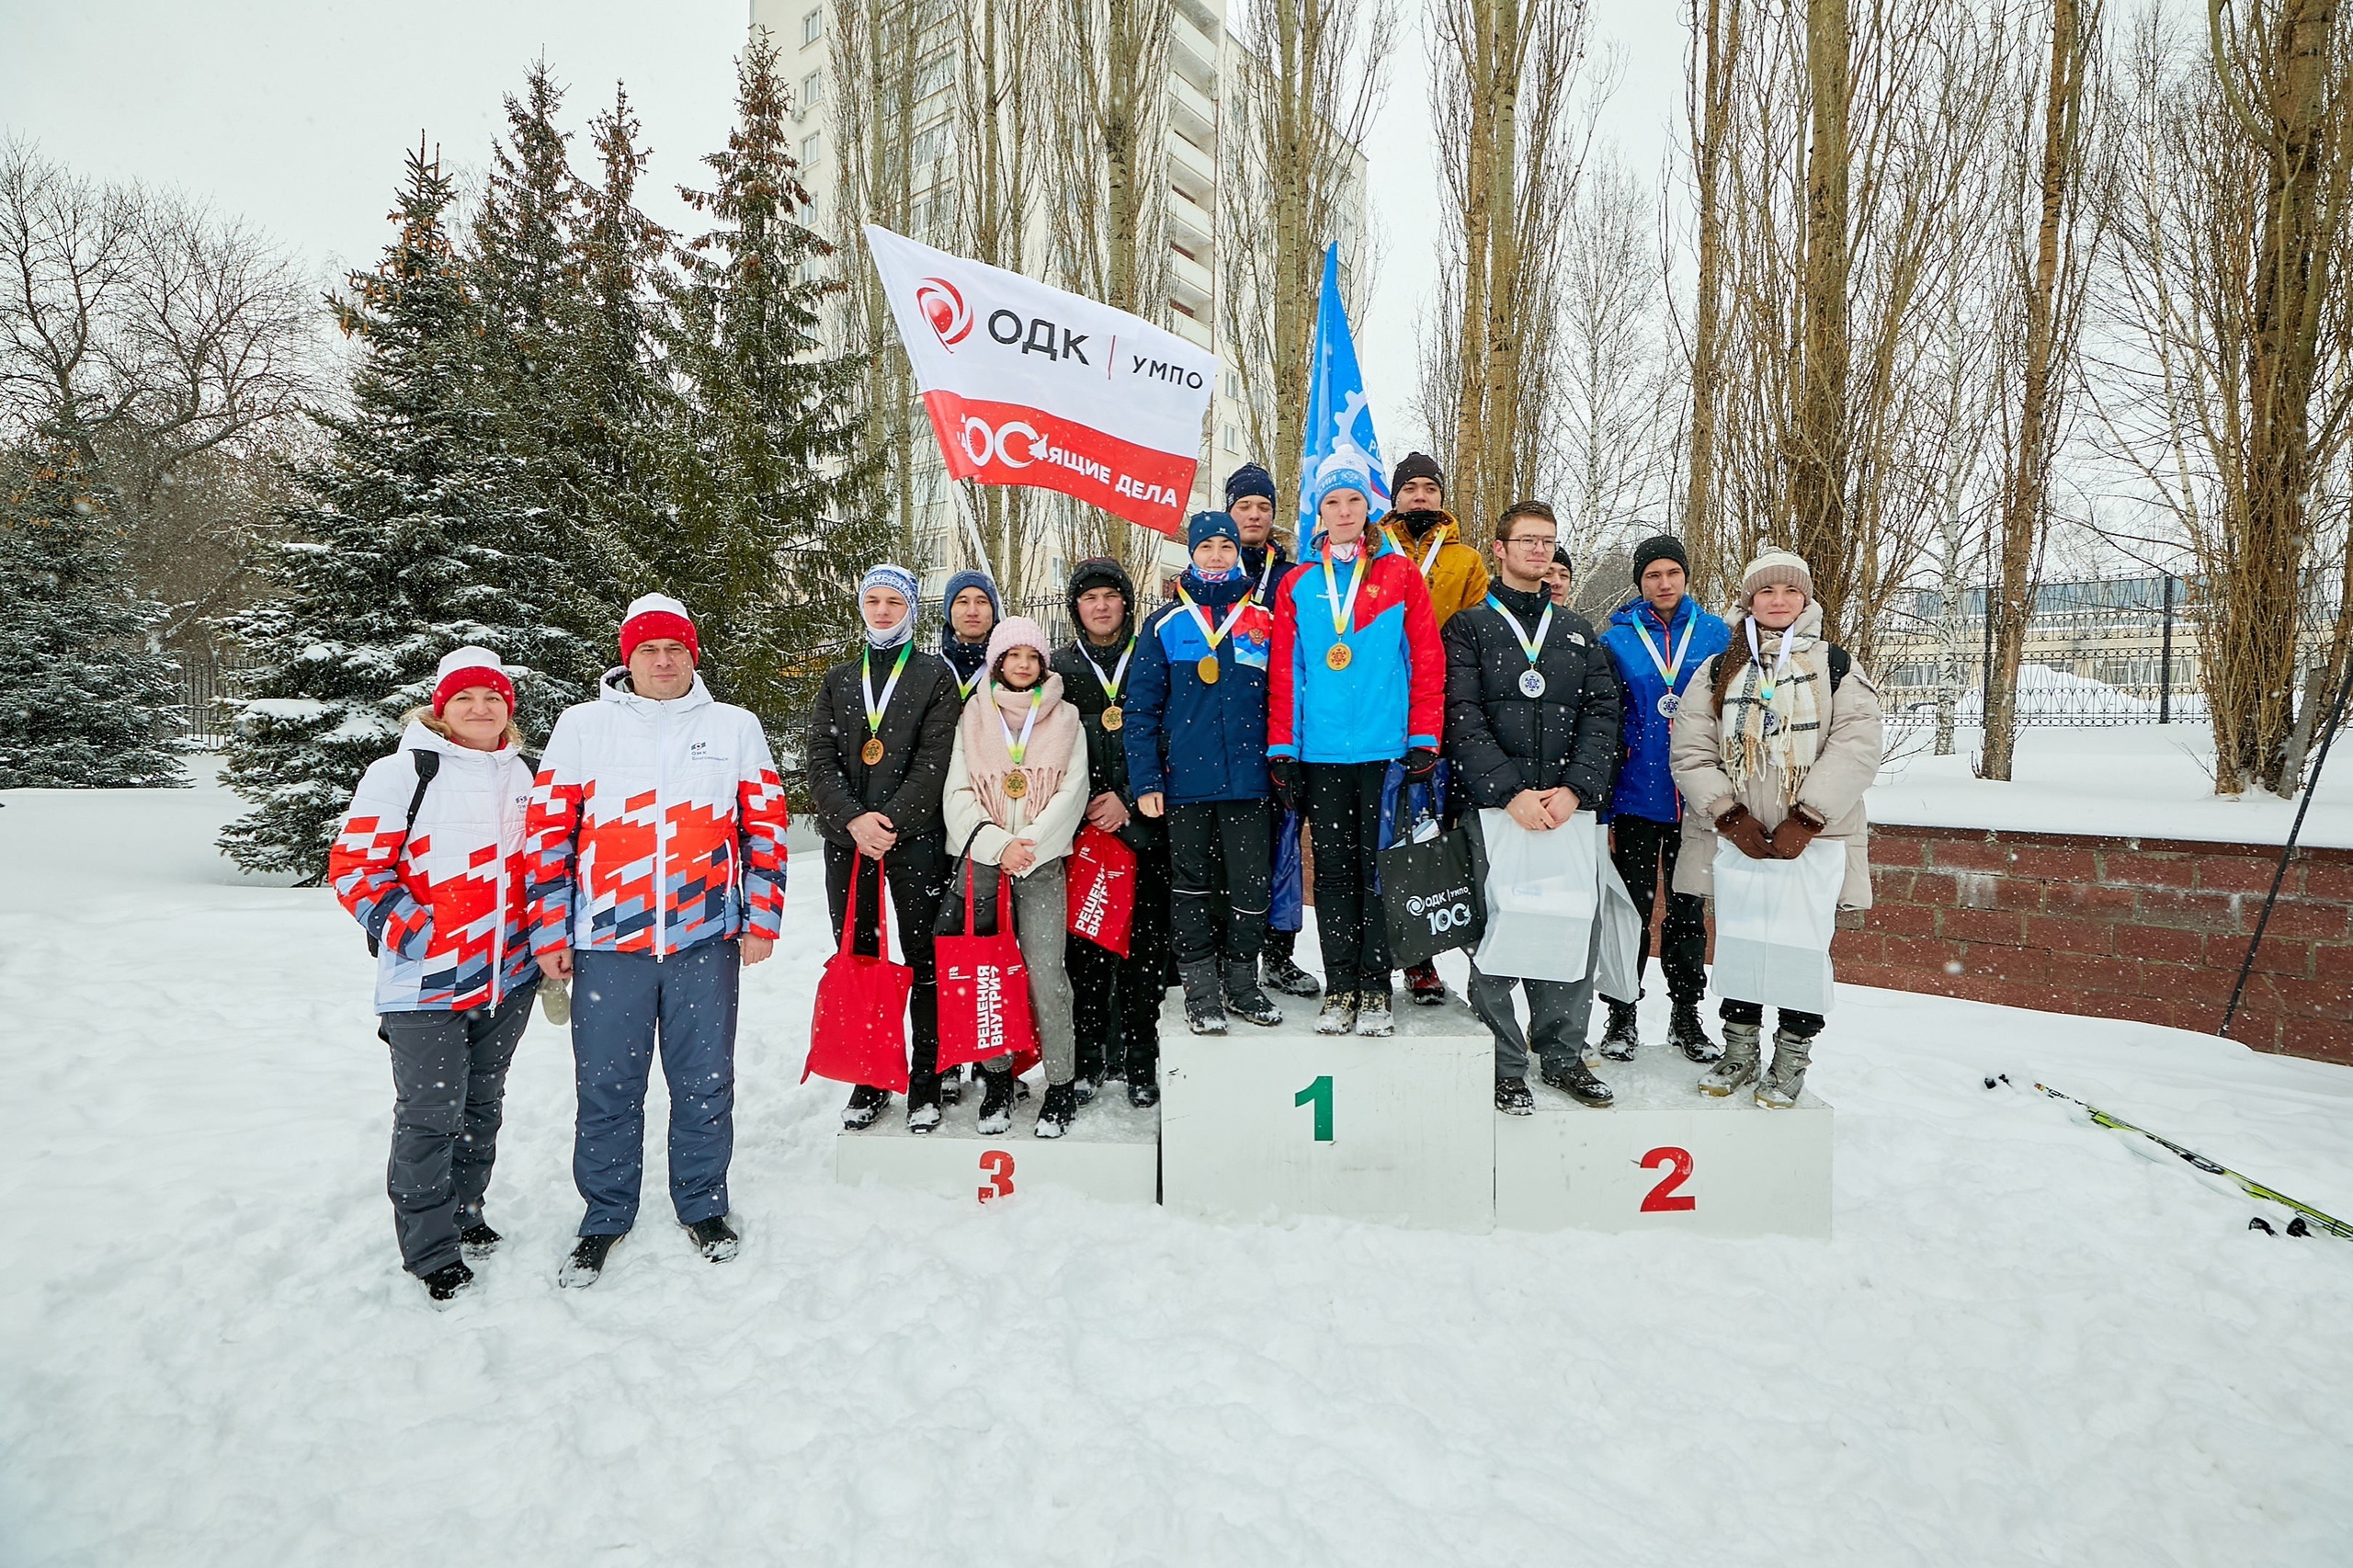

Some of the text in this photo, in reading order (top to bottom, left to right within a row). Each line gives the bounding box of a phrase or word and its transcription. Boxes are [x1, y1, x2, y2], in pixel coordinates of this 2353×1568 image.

[988, 309, 1203, 390] ОДК УМПО
[1115, 473, 1177, 508] ДЕЛА
[1074, 862, 1106, 932] РЕШЕНИ
[1086, 881, 1108, 937] ВНУТР
[1426, 886, 1469, 907] ОДК УМПО
[976, 965, 990, 1049] РЕШЕНИЯ
[989, 977, 1004, 1047] ВНУТРИ
[1294, 1075, 1334, 1142] 1
[978, 1150, 1015, 1204] 3
[1640, 1146, 1696, 1212] 2
